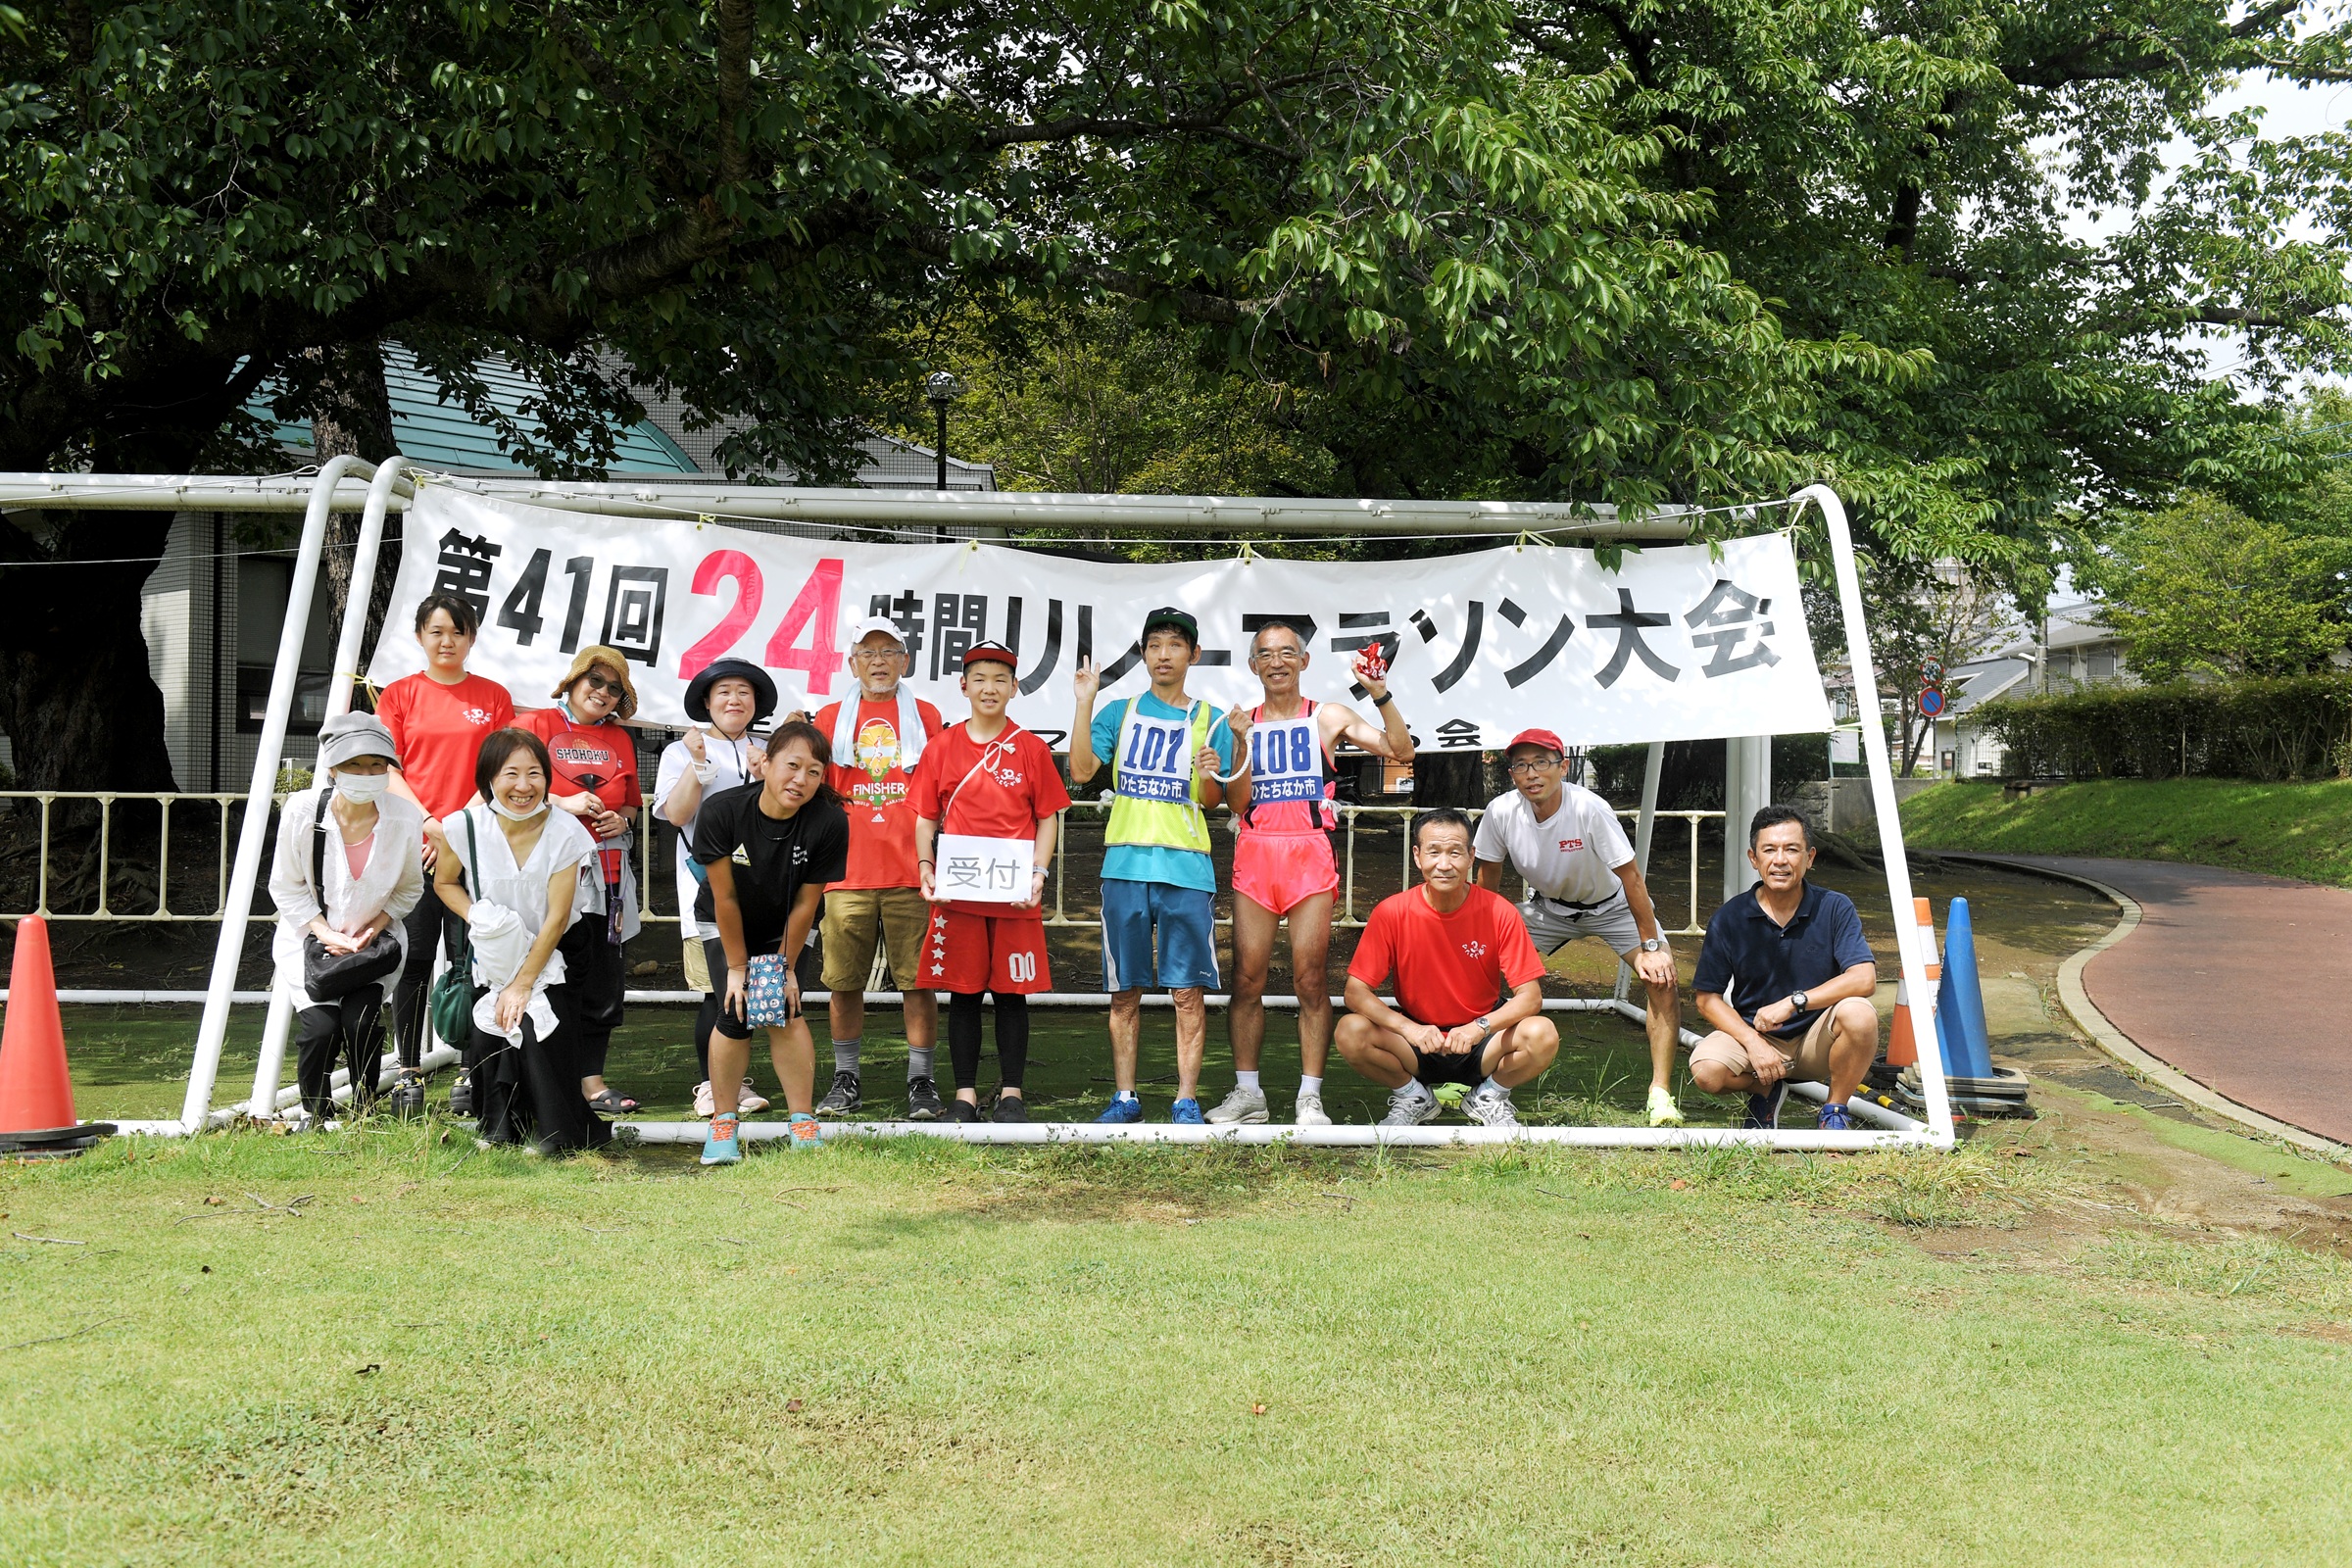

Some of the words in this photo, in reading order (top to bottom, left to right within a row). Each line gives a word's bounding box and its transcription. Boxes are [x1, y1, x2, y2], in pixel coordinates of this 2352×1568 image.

[556, 748, 610, 761] SHOHOKU
[1123, 722, 1186, 774] 107
[1251, 726, 1310, 777] 108
[853, 782, 906, 797] FINISHER
[1120, 773, 1183, 799] ひたちなか市
[1251, 778, 1316, 801] ひたちなか市
[1558, 838, 1583, 849] PTS
[947, 857, 1021, 890] 受付
[1007, 951, 1037, 983] 00
